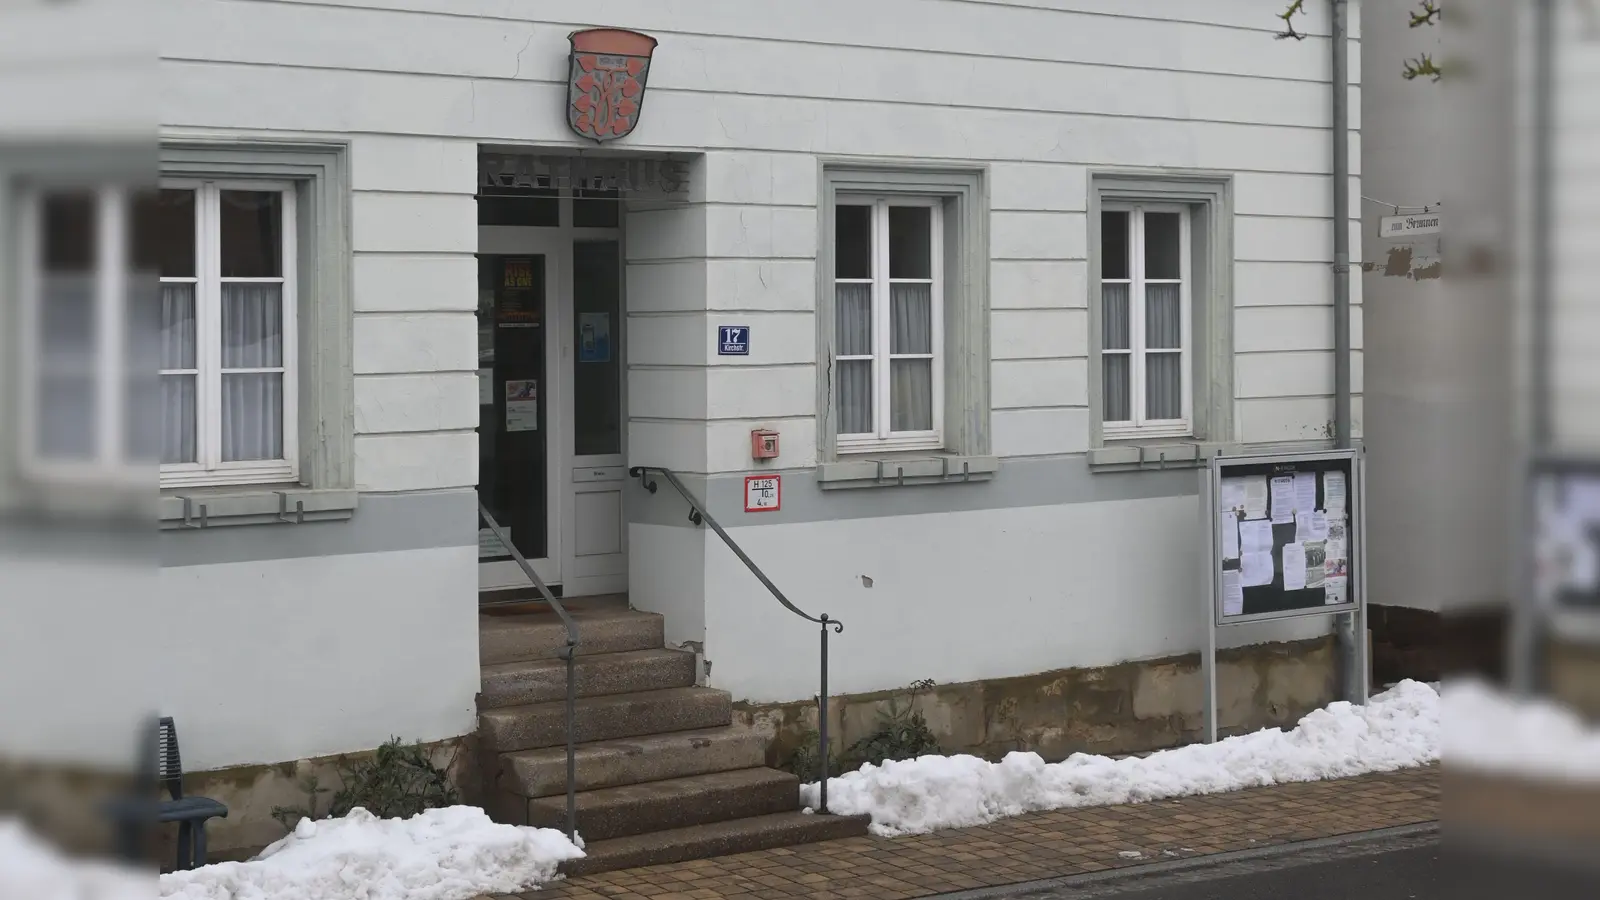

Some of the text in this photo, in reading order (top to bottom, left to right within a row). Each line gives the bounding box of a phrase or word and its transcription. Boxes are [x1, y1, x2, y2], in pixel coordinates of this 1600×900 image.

[1405, 217, 1439, 230] Brunnen
[504, 276, 533, 288] AS ONE
[725, 328, 741, 343] 17
[754, 480, 773, 488] H 125
